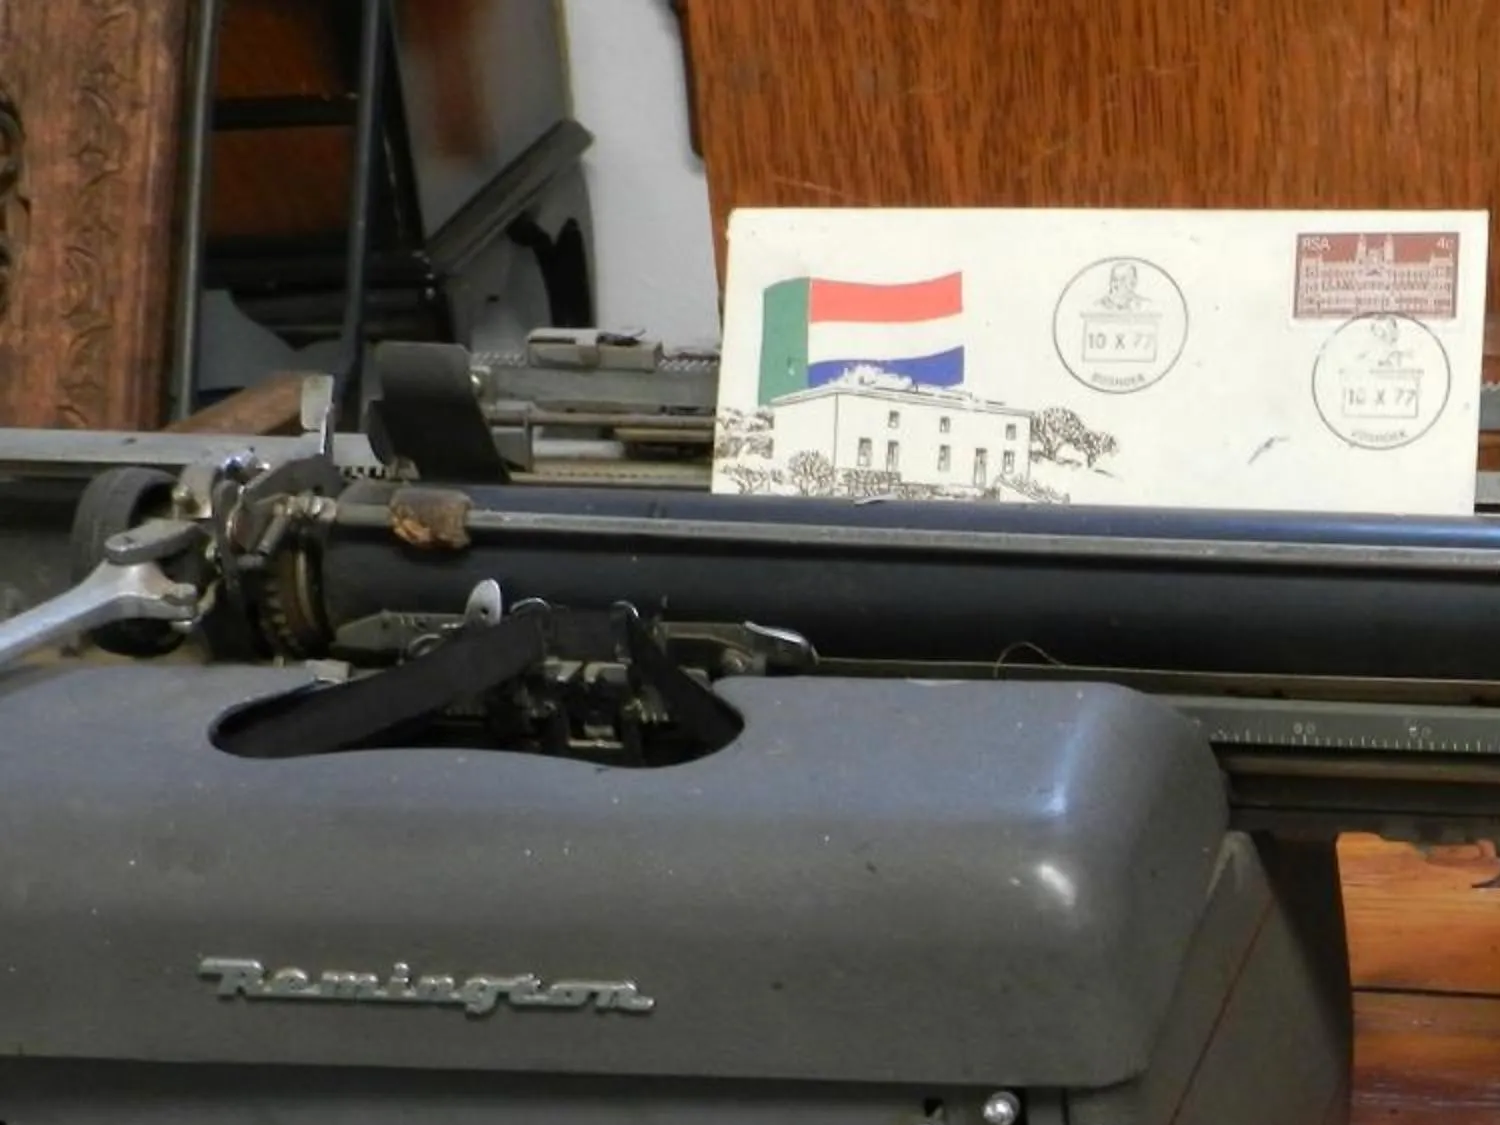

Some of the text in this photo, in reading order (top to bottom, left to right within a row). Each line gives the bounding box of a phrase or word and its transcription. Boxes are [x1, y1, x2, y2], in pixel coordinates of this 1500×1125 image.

[1087, 331, 1107, 350] 10
[1114, 333, 1126, 350] X
[1374, 386, 1386, 406] X
[199, 954, 655, 1019] Remington
